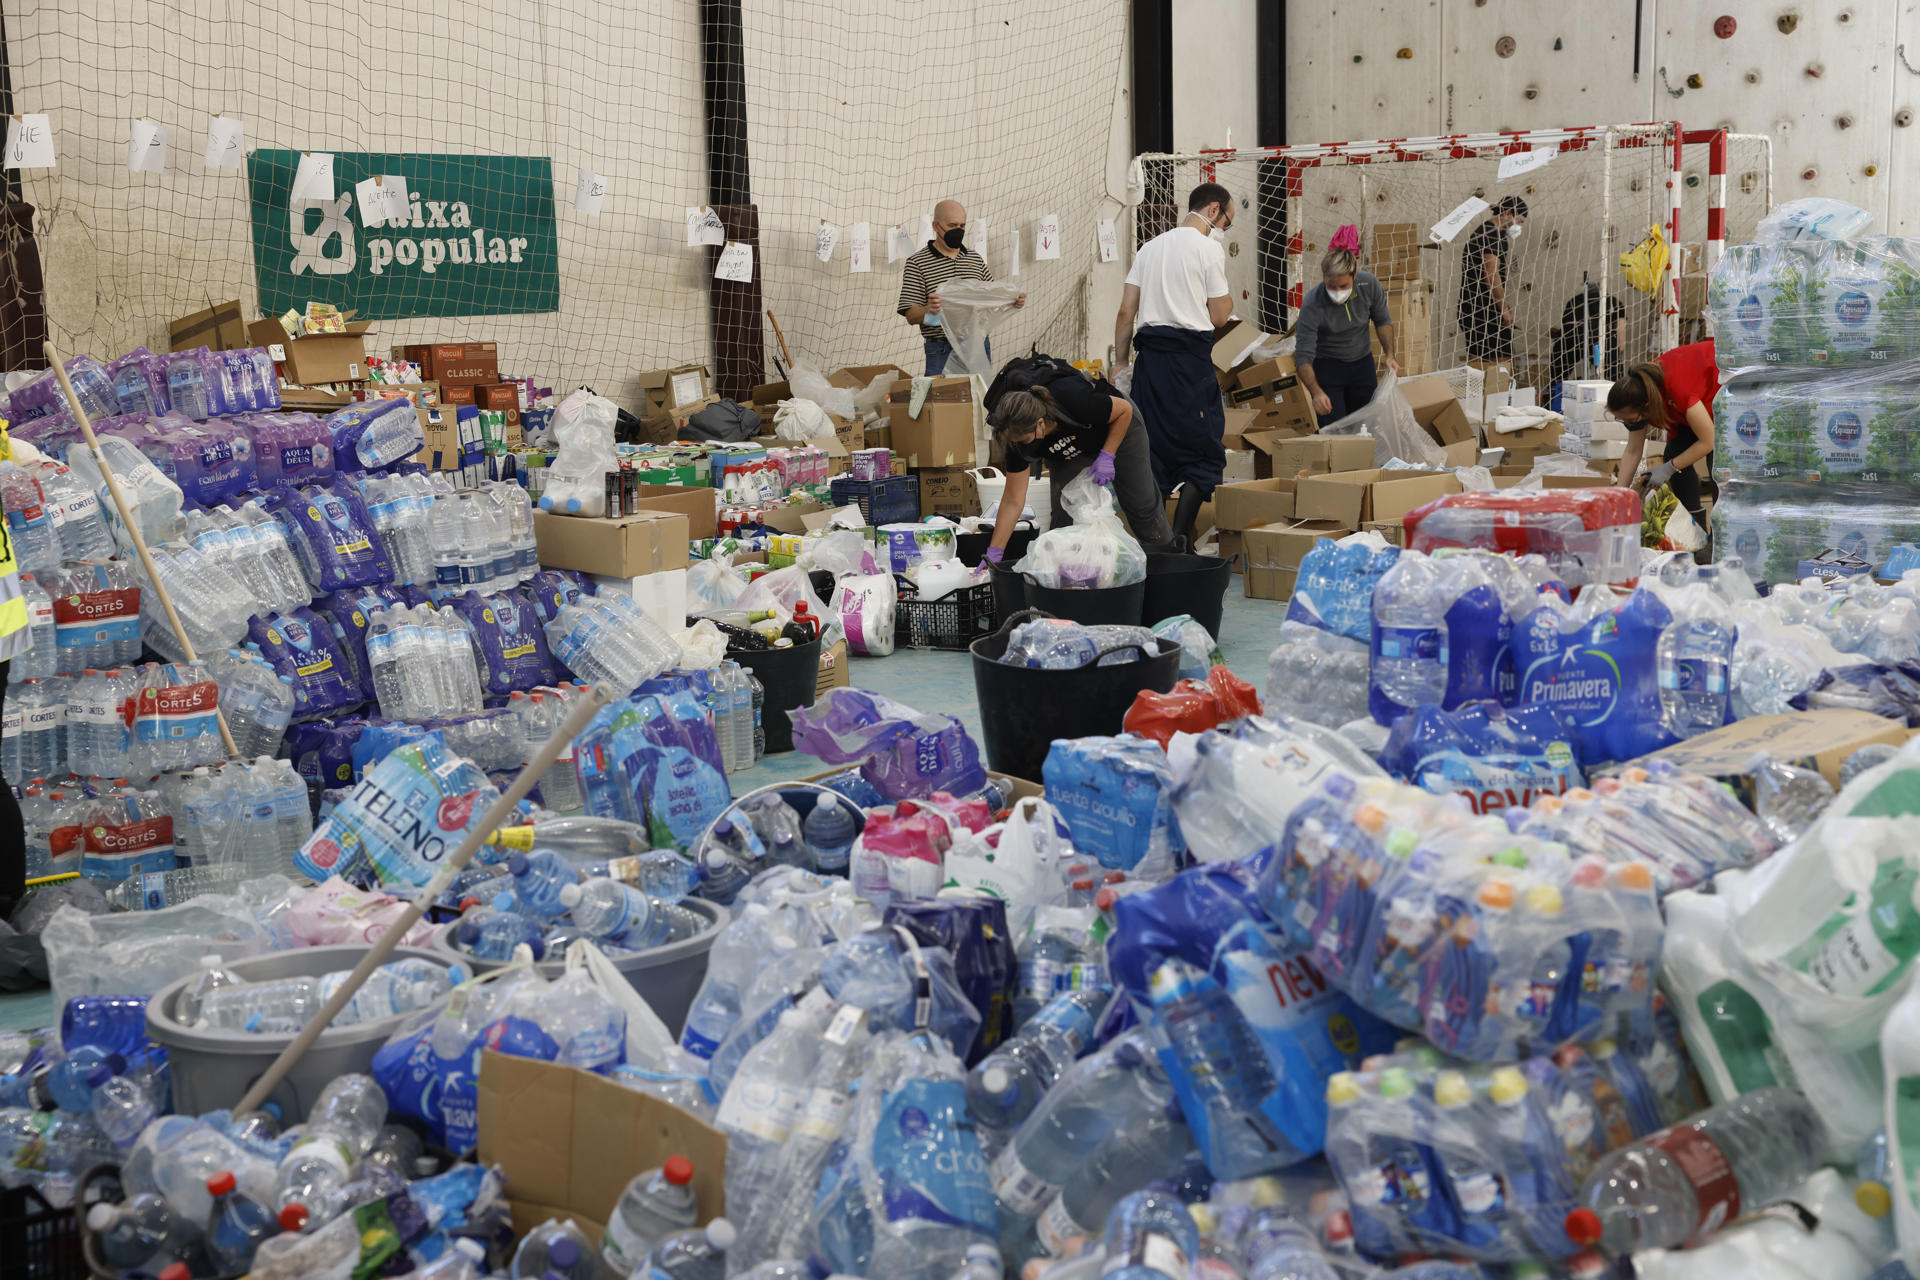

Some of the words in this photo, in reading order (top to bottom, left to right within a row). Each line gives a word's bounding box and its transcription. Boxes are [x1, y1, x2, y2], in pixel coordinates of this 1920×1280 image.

[367, 228, 528, 275] popular
[438, 349, 462, 358] Pascual
[446, 368, 483, 378] CLASSIC
[449, 391, 470, 399] Pascual
[491, 391, 512, 399] Pascual
[425, 423, 448, 431] FRAGIL
[202, 443, 230, 456] AQUA
[284, 449, 311, 458] AQUA
[206, 450, 231, 463] DEUS
[286, 456, 310, 465] DEUS
[925, 476, 949, 486] CONEJO
[69, 496, 96, 512] CORTES
[77, 599, 124, 615] CORTES
[1531, 677, 1612, 702] Primavera
[31, 711, 57, 723] CORTES
[919, 736, 929, 773] AQUA
[928, 736, 939, 770] DEUS
[1489, 773, 1510, 785] del
[1513, 772, 1554, 788] Segura
[1051, 784, 1089, 810] fuente
[353, 779, 445, 862] TELENO
[104, 828, 158, 848] CORTES
